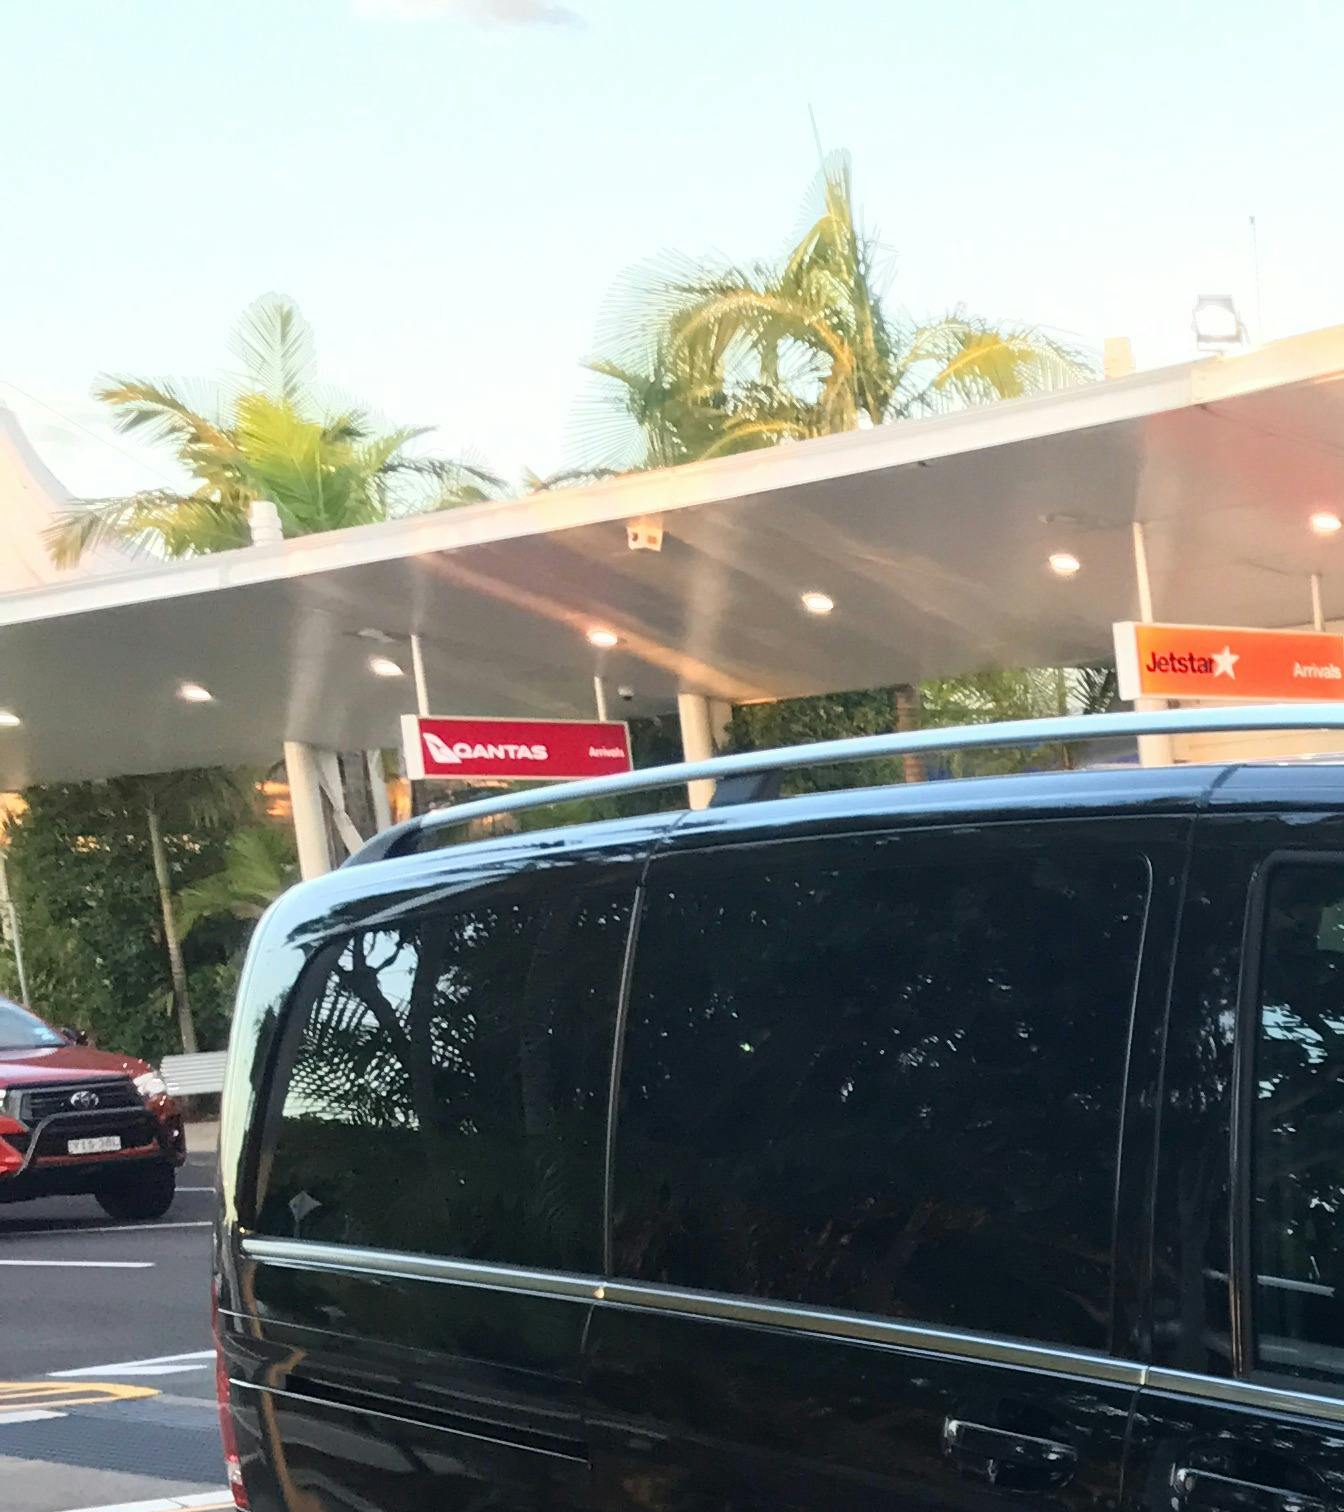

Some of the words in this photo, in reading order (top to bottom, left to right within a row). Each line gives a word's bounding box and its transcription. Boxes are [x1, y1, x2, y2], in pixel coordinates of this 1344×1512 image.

[1146, 652, 1215, 674] Jetstar
[1293, 661, 1343, 680] Arrivals
[453, 743, 549, 761] QANTAS
